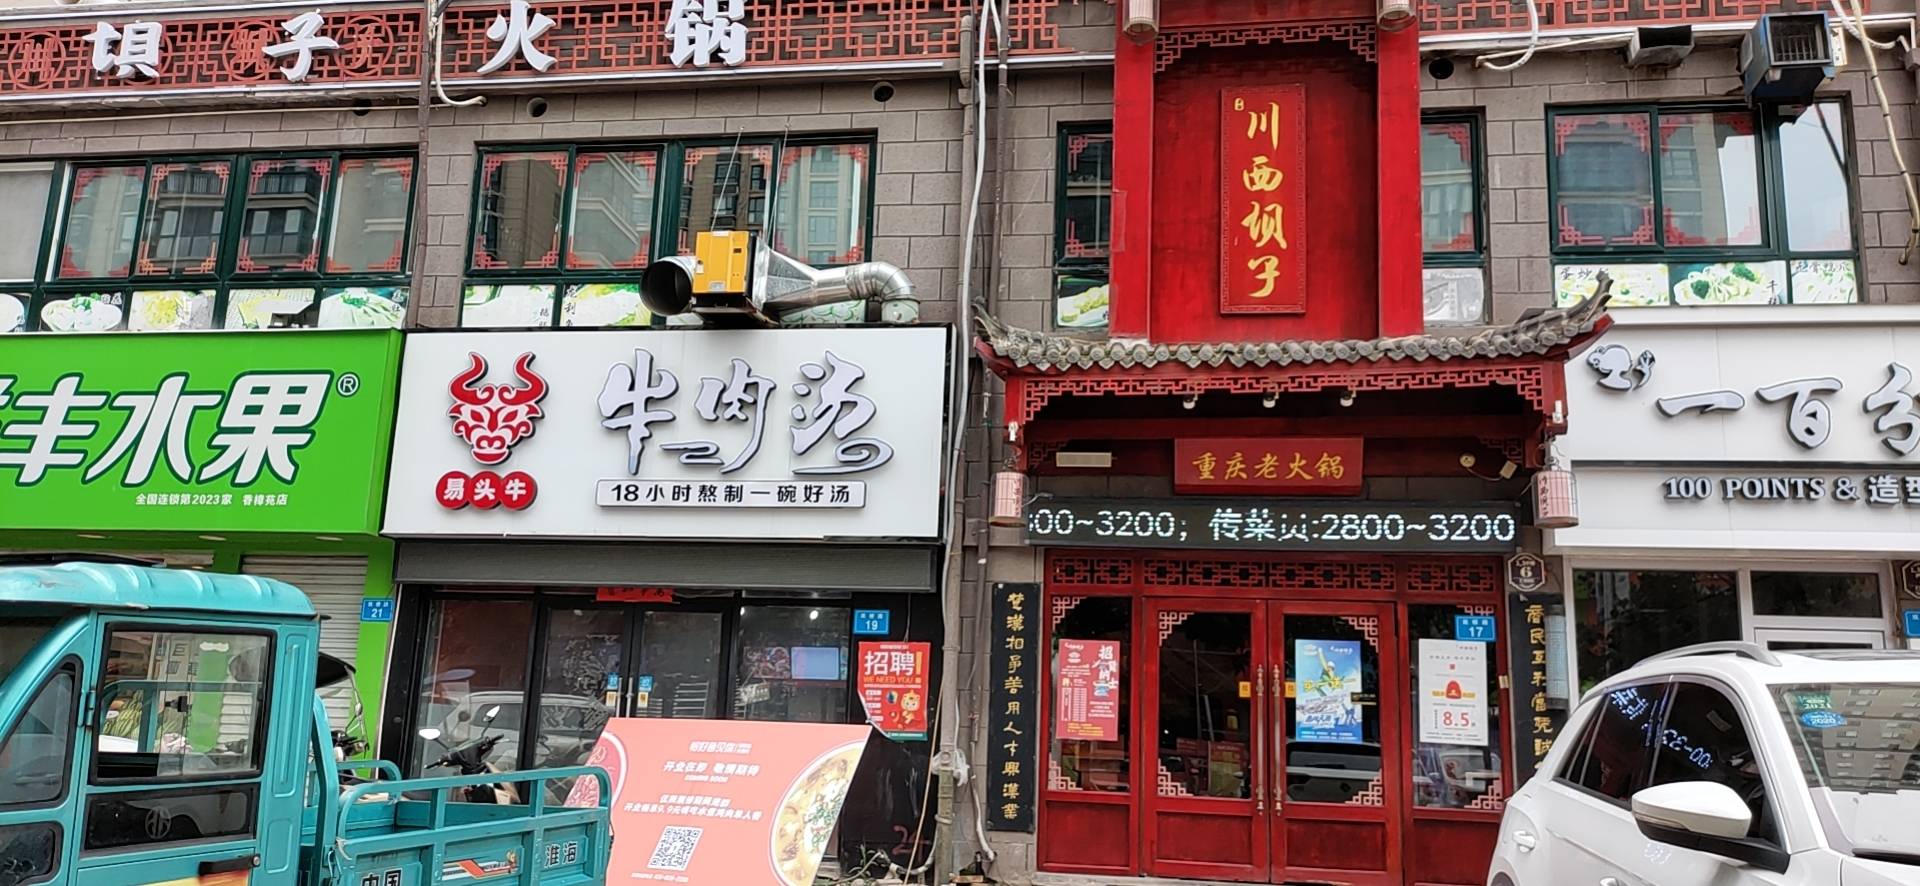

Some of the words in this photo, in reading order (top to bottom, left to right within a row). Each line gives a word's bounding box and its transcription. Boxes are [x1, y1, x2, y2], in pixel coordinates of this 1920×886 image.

[1241, 102, 1287, 298] 川西坝子
[1560, 267, 1608, 280] 蛋炒
[597, 348, 895, 476] 牛肉汤
[1191, 452, 1345, 481] 重庆老火锅
[443, 477, 527, 500] 易头牛
[611, 484, 852, 504] 18小时熬制一碗好汤
[1663, 476, 1712, 499] 100
[1723, 476, 1826, 500] POINTS
[1834, 476, 1860, 501] &
[135, 492, 232, 506] 全国连锁第2023家
[1520, 566, 1532, 578] 6
[371, 608, 383, 618] 21
[865, 620, 878, 631] 19
[1469, 627, 1483, 638] 17
[544, 841, 578, 867] 淮海
